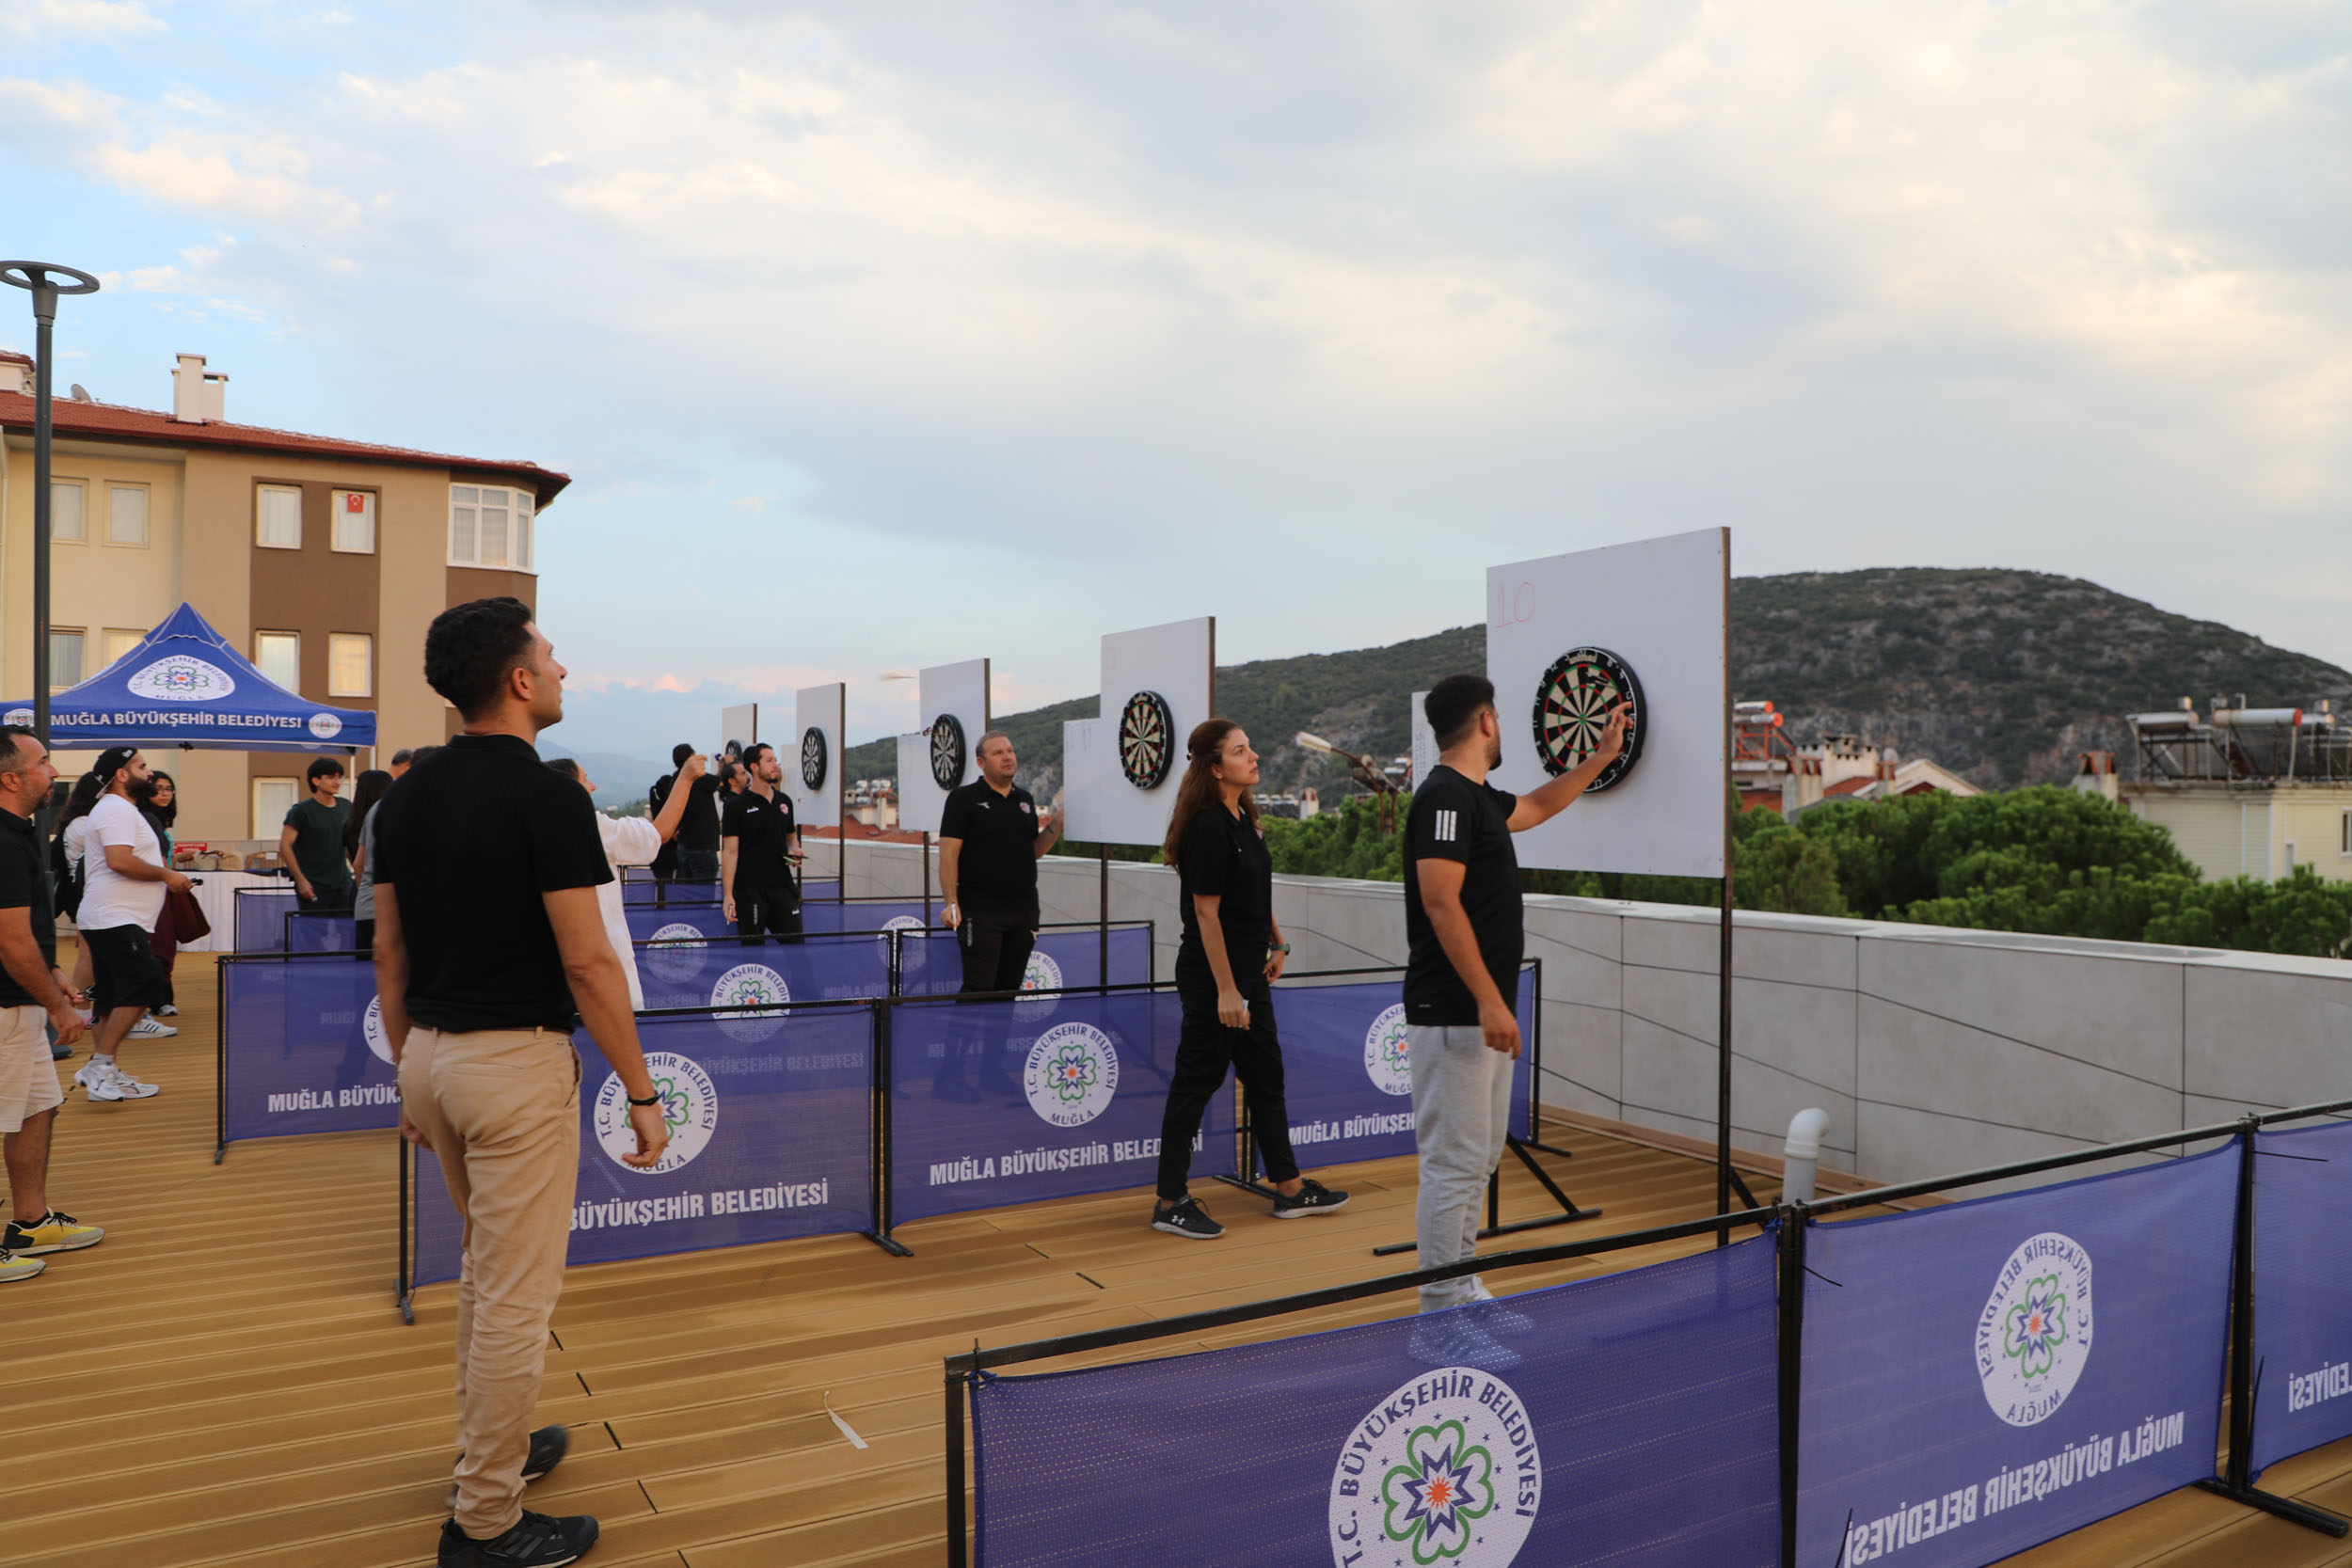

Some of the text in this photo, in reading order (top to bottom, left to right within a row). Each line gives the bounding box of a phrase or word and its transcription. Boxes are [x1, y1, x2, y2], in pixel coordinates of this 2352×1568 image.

[1495, 581, 1536, 628] 10
[51, 711, 111, 725] MUĞLA
[114, 710, 215, 727] BÜYÜKŞEHİR
[1029, 1023, 1088, 1069] BÜYÜKŞEHİR
[600, 1053, 677, 1107] BÜYEHİR
[1027, 1073, 1039, 1098] T.C.
[1384, 1083, 1412, 1094] MUĞL
[268, 1084, 401, 1113] MUĞLA BÜYÜK
[599, 1111, 612, 1139] T.C.
[1050, 1110, 1095, 1125] MUĞLA
[1288, 1112, 1416, 1146] MUĞLA BÜYÜKŞEH
[930, 1156, 996, 1186] MUĞLA
[1001, 1141, 1109, 1177] BÜYÜKŞEHİR
[711, 1178, 829, 1216] BELEDİYESİ
[1339, 1370, 1474, 1497] BÜYÜKŞEHİR
[1478, 1381, 1536, 1518] BELEDİYESİ
